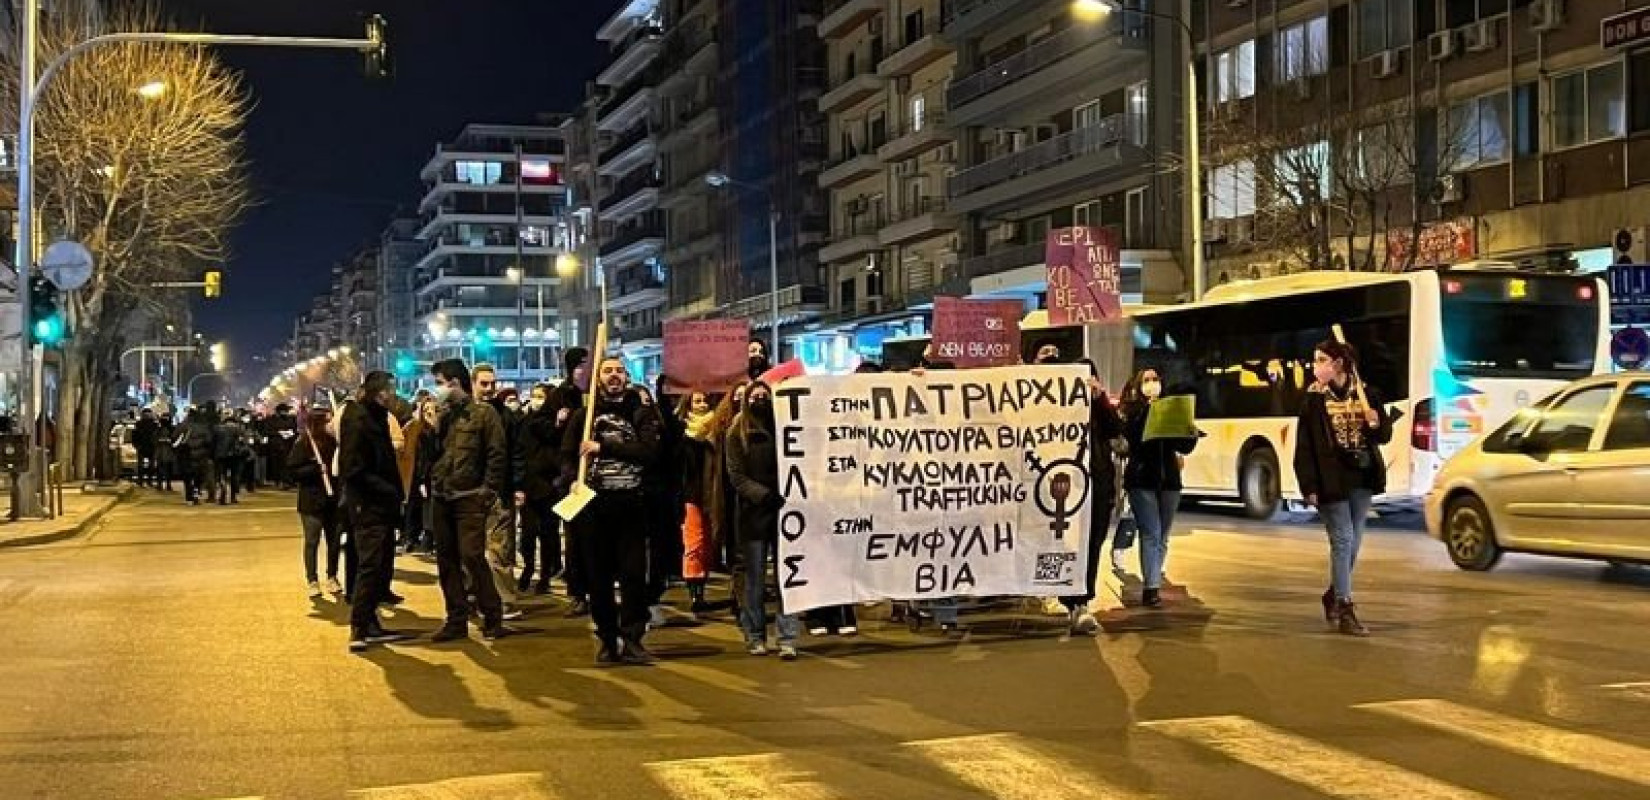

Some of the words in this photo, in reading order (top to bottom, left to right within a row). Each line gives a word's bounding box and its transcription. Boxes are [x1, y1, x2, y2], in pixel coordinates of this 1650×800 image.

[938, 341, 964, 358] ΔΕΝ
[829, 397, 869, 413] ΣΤΗΝ
[871, 377, 1090, 420] ΠΑΤΡΙΑΡΧΙΑ
[828, 424, 867, 440] ΣΤΗΝ
[867, 425, 992, 451] ΚΟΥΛΤΟΥΡΑ
[997, 421, 1090, 449] ΒΙΑΣΜΟΥ
[828, 455, 857, 473] ΣΤΑ
[863, 461, 1013, 488] ΚΥΚΛΩΜΑΤΑ
[897, 483, 1027, 512] TRAFFICKING
[833, 514, 873, 535] ΣΤΗΝ
[866, 522, 1014, 560] ΕΜΦΥΛΗ
[915, 562, 976, 593] ΒΙΑ
